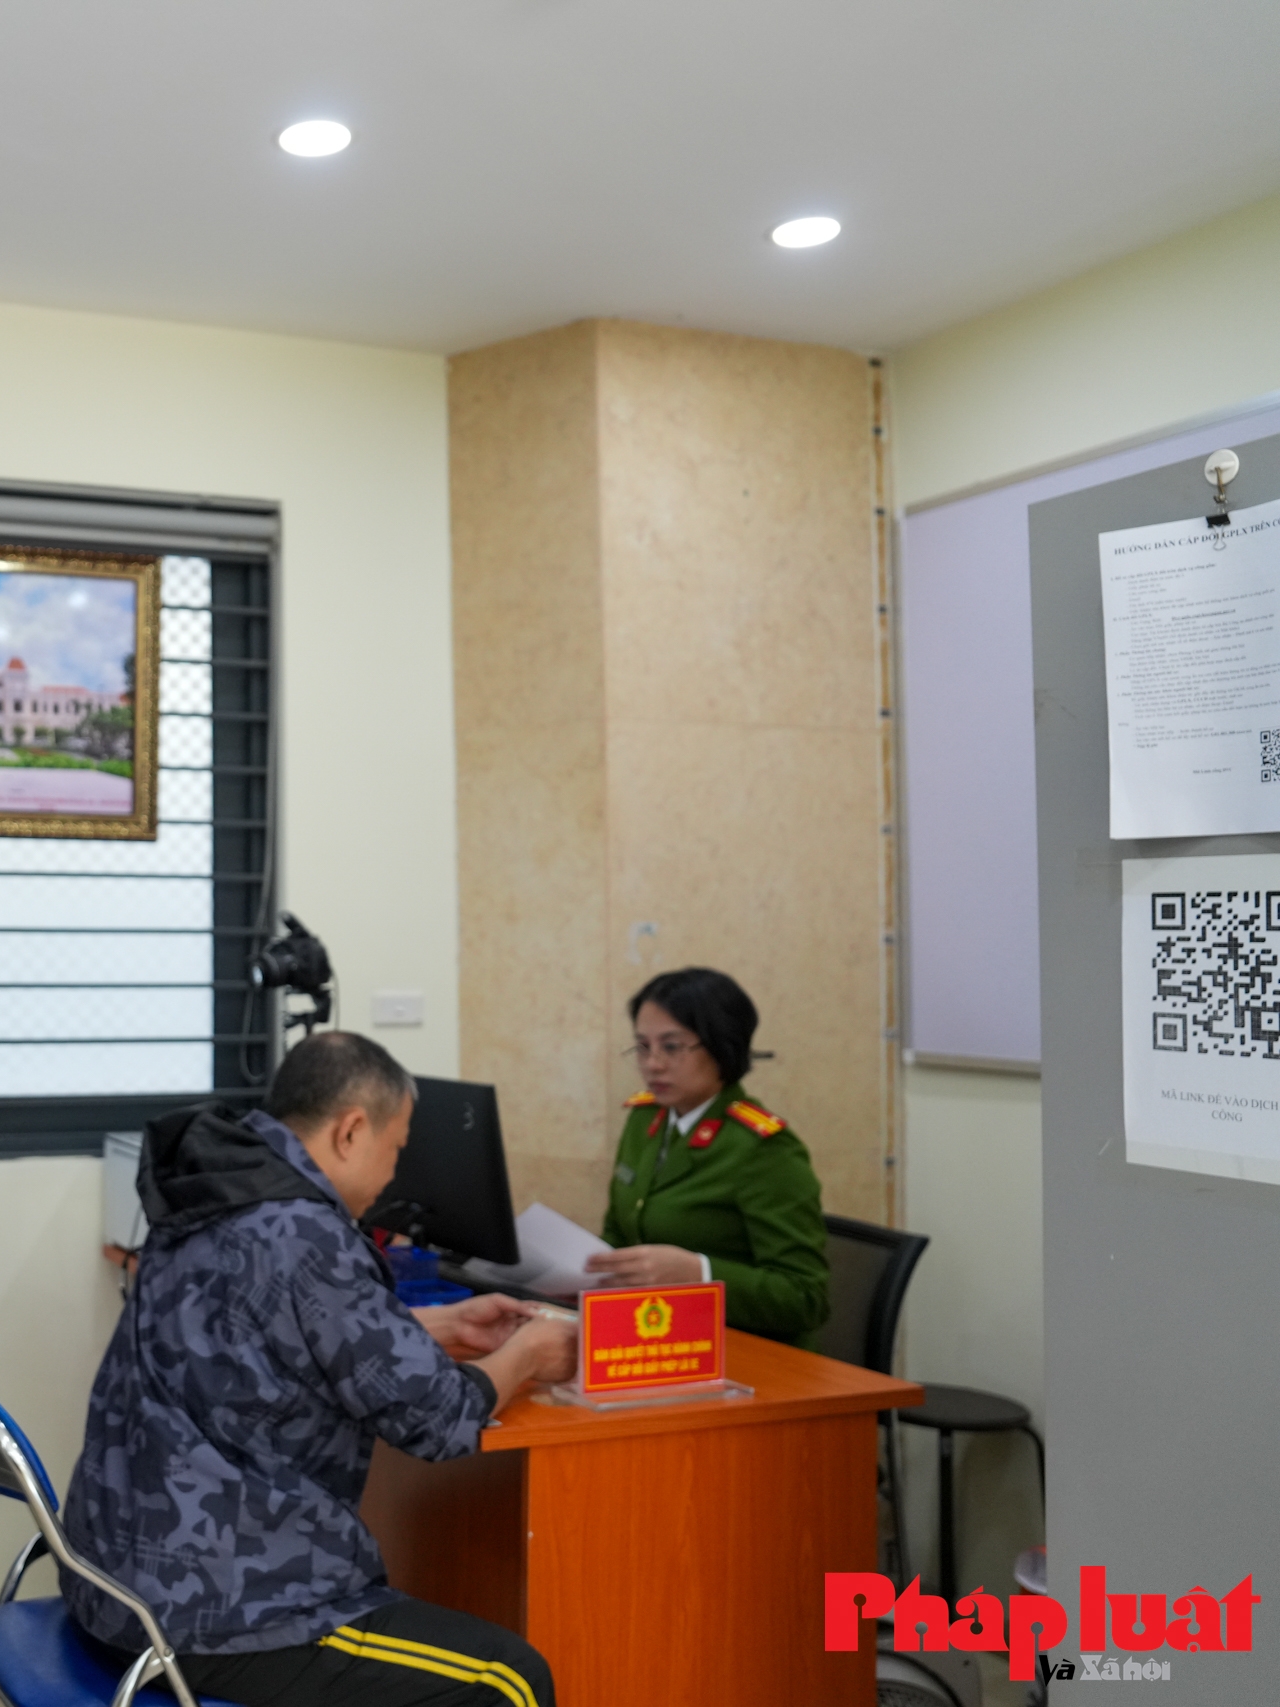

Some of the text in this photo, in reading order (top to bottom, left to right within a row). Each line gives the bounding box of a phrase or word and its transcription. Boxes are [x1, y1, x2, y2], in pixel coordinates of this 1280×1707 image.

[1250, 520, 1271, 533] TRÊN
[1161, 1088, 1177, 1100] MÃ
[1180, 1091, 1205, 1103] LINK
[1224, 1094, 1248, 1107] VÀO
[1251, 1099, 1279, 1110] DỊCH
[1211, 1109, 1243, 1122] CÔNG
